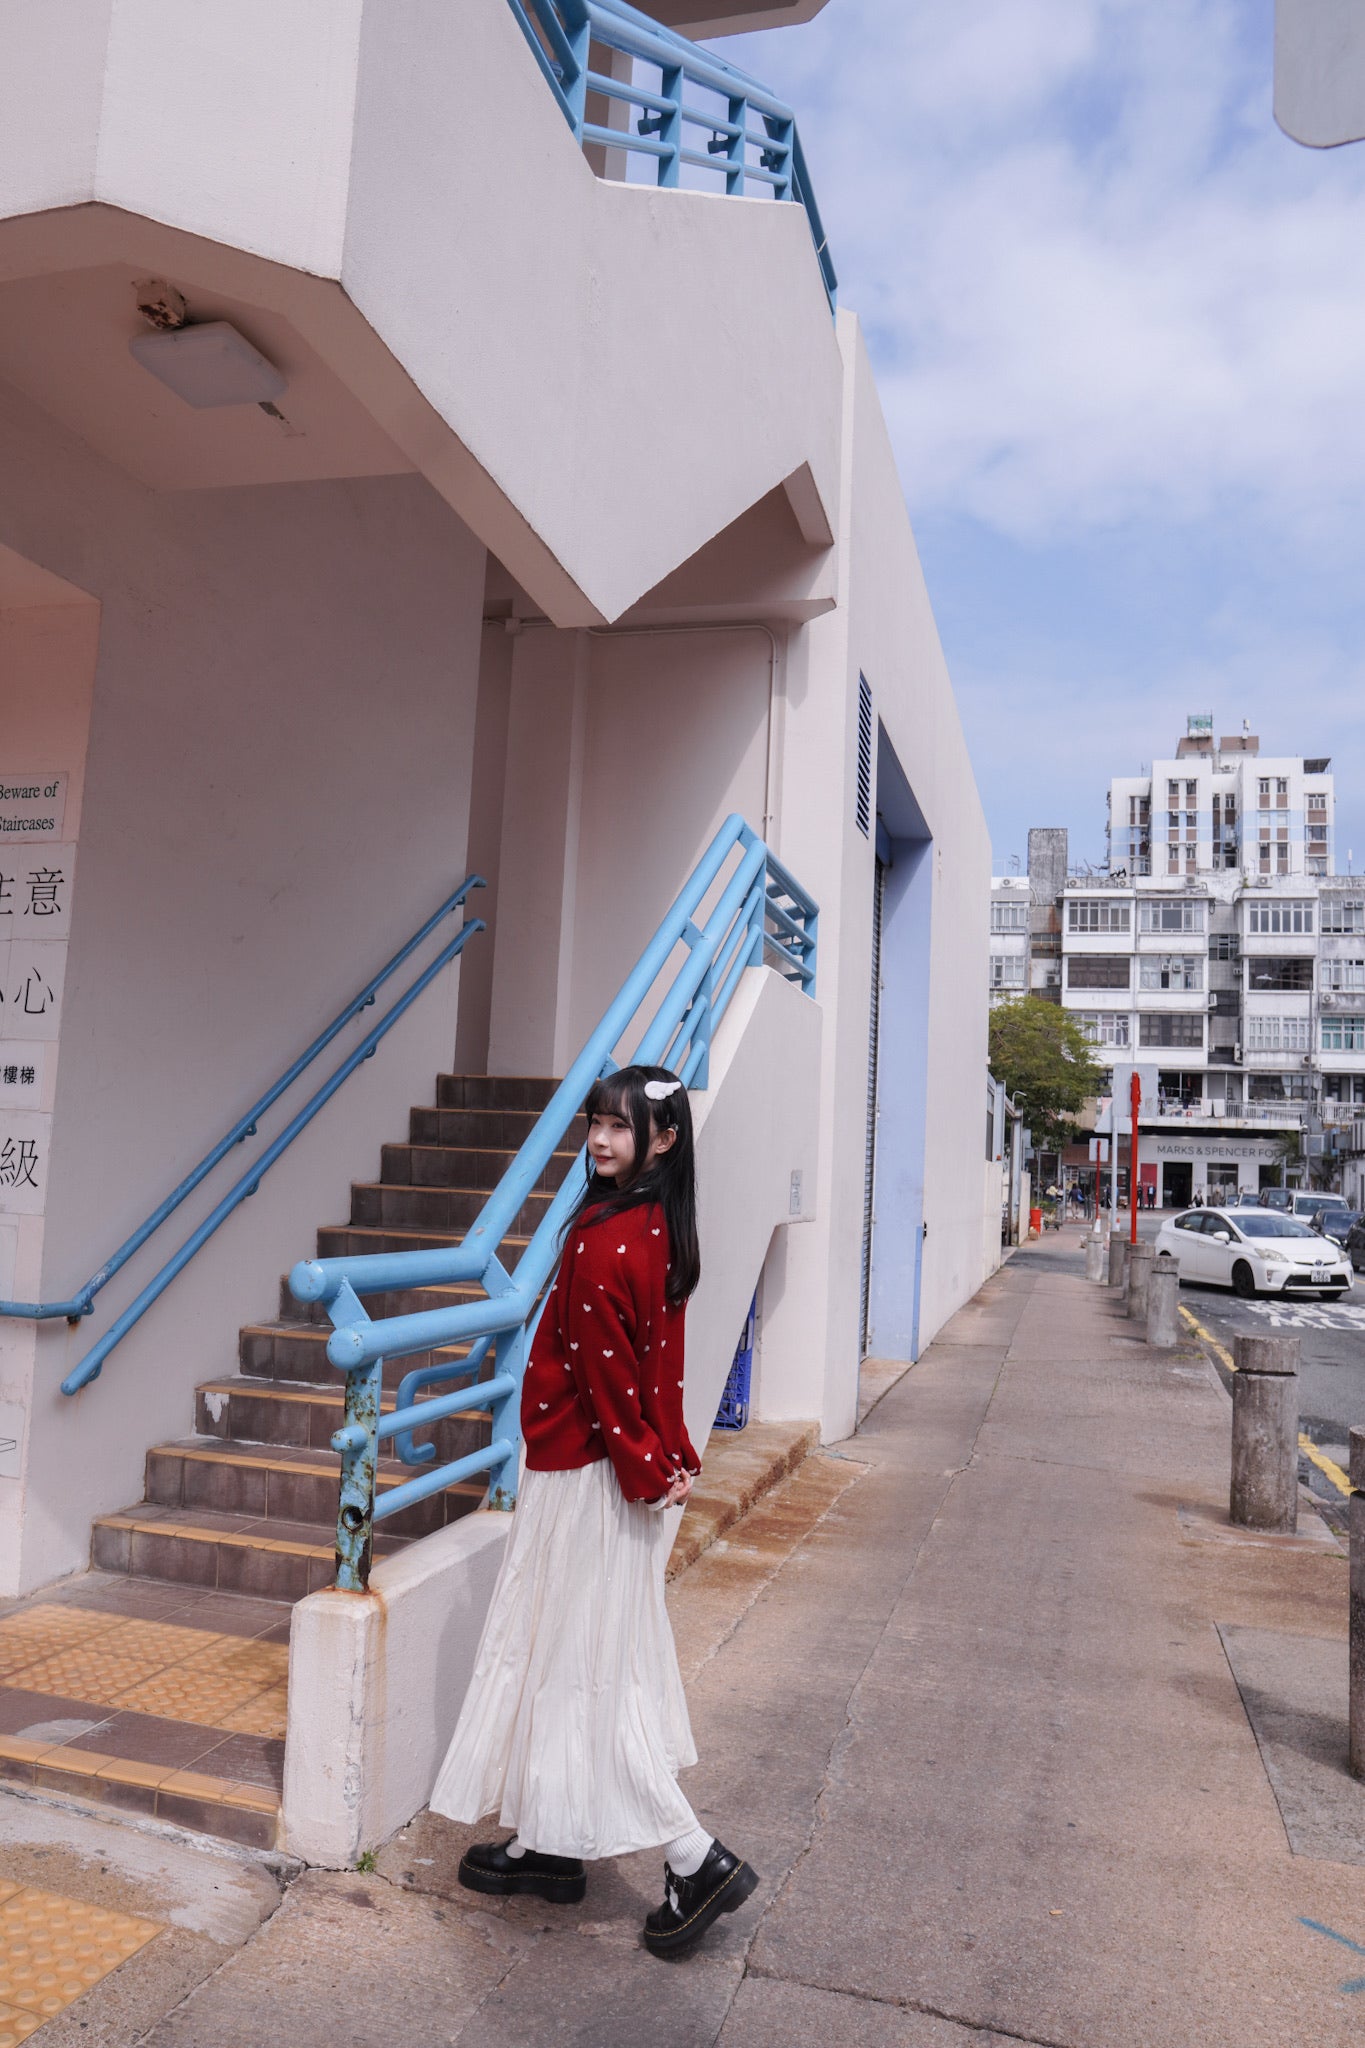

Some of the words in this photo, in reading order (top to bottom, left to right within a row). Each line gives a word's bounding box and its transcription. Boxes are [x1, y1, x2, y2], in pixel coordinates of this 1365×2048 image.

[44, 781, 59, 798] of
[0, 966, 54, 1014] 心
[0, 1065, 35, 1085] 樓梯
[1157, 1145, 1194, 1156] MARKS
[1196, 1146, 1203, 1156] &
[1205, 1146, 1256, 1158] SPENCER
[1258, 1148, 1284, 1159] FOO
[0, 1137, 39, 1188] 級
